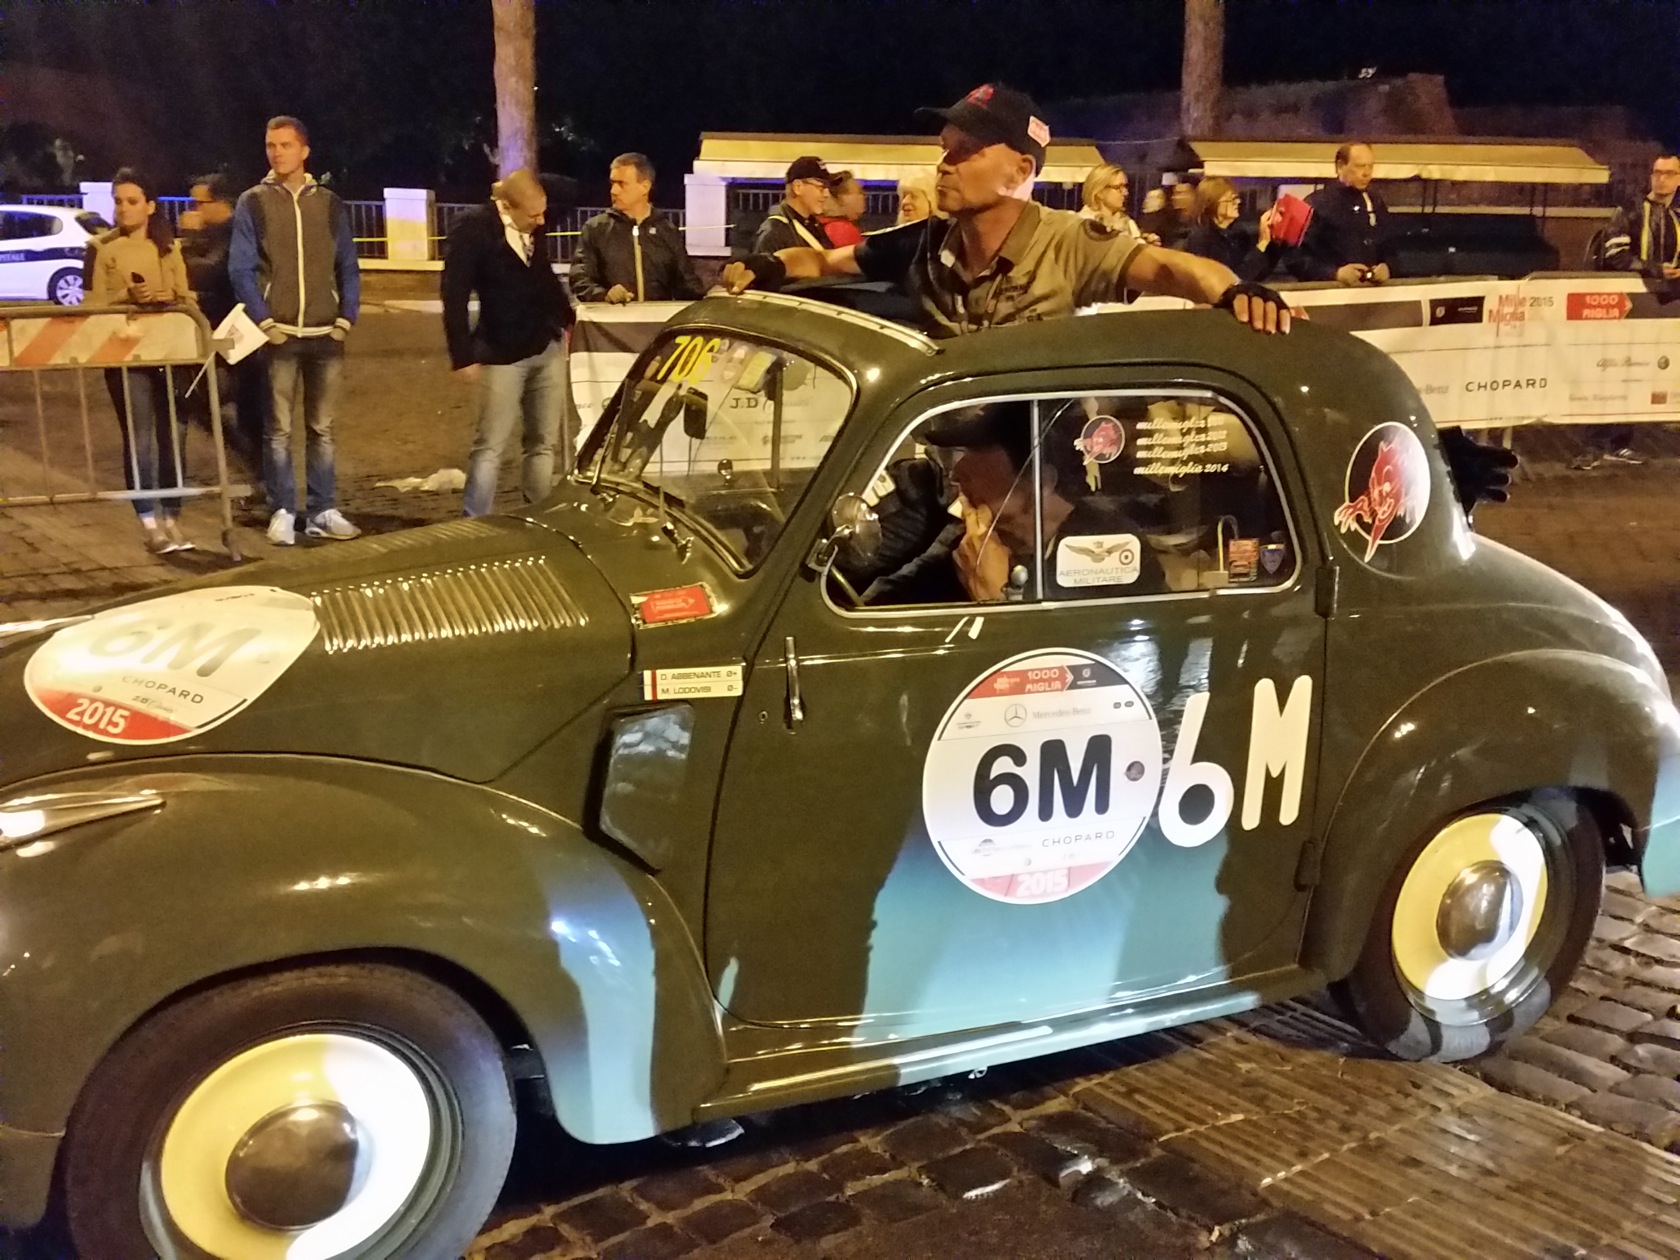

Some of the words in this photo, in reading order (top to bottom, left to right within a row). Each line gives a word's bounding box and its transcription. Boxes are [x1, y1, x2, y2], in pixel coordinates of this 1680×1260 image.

[1529, 296, 1554, 307] 2015
[1585, 294, 1619, 305] 1000
[657, 336, 721, 384] 706
[1465, 378, 1548, 392] CHOPARD
[1204, 463, 1230, 473] 2014
[1059, 567, 1138, 576] AERONAUTICA
[1073, 576, 1124, 585] MILITARE
[88, 620, 262, 677] 6M
[1027, 669, 1060, 680] 1000
[122, 676, 204, 704] CHOPARD
[1025, 680, 1062, 693] MIGLIA
[66, 698, 131, 734] 2015
[1158, 692, 1234, 848] 6
[1241, 675, 1313, 831] M
[973, 734, 1112, 828] 6M
[1041, 830, 1115, 848] CHOPARD
[1016, 869, 1068, 897] 2015
